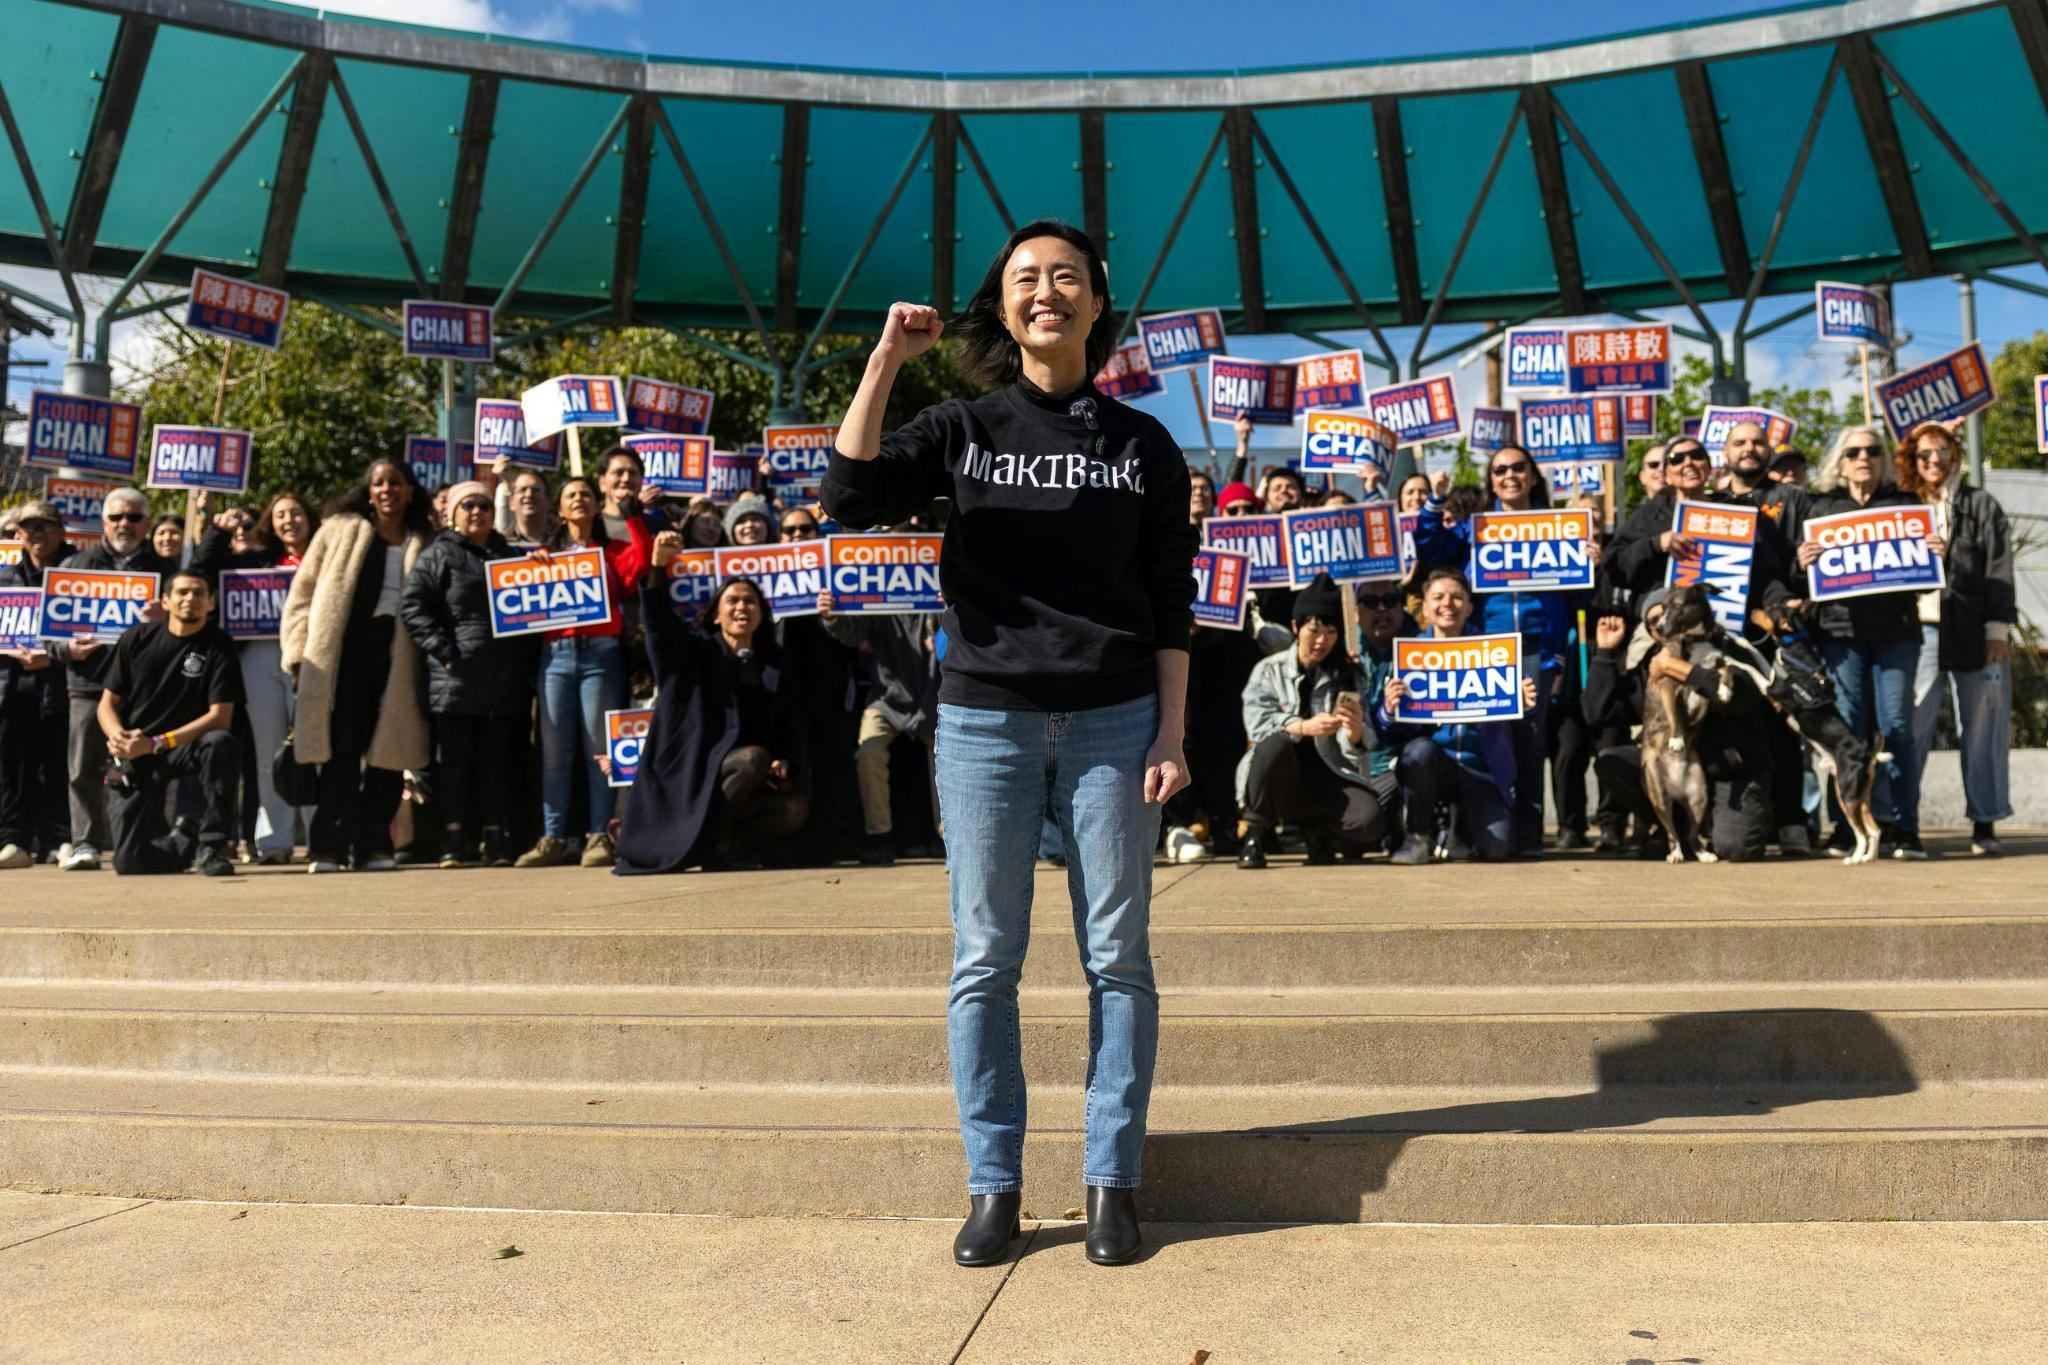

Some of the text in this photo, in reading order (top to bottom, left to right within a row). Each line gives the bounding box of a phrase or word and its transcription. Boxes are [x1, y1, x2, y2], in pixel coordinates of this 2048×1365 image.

[1825, 299, 1876, 330] CHAN
[411, 316, 465, 345] CHAN
[1147, 326, 1200, 358] CHAN
[1513, 330, 1563, 345] conni
[1574, 330, 1664, 365] 陳詩敏
[563, 389, 588, 413] AN
[1214, 376, 1266, 409] CHAN
[1526, 399, 1588, 417] connie
[1890, 375, 1960, 427] CHAN
[1375, 397, 1431, 432] CHAN
[35, 418, 106, 456] CHAN
[634, 436, 680, 452] onnie
[773, 428, 834, 450] conni
[1314, 419, 1395, 448] connie
[1526, 414, 1592, 448] CHAN
[157, 442, 216, 474] CHAN
[640, 451, 681, 478] HAN
[770, 448, 830, 472] CHA
[1309, 433, 1394, 472] CHAN
[50, 497, 103, 516] CHA
[1293, 510, 1360, 534] connie
[1213, 519, 1275, 539] connie
[1483, 514, 1580, 543] connie
[1818, 511, 1925, 550] connie
[727, 546, 818, 576] connie
[839, 539, 936, 566] connie
[1294, 526, 1364, 567] CHAN
[1478, 540, 1588, 571] CHAN
[1819, 539, 1930, 577] CHAN
[499, 556, 594, 588] connie
[756, 569, 820, 600] HAN
[834, 565, 941, 593] CHAN
[0, 595, 39, 607] onni
[54, 577, 148, 600] connie
[496, 577, 602, 615] CHAN
[669, 576, 715, 603] CH
[1704, 543, 1753, 633] HAN
[47, 597, 149, 625] CHAN
[227, 589, 287, 620] CHAN
[1407, 640, 1509, 671] connie
[1402, 666, 1515, 700] CHAN
